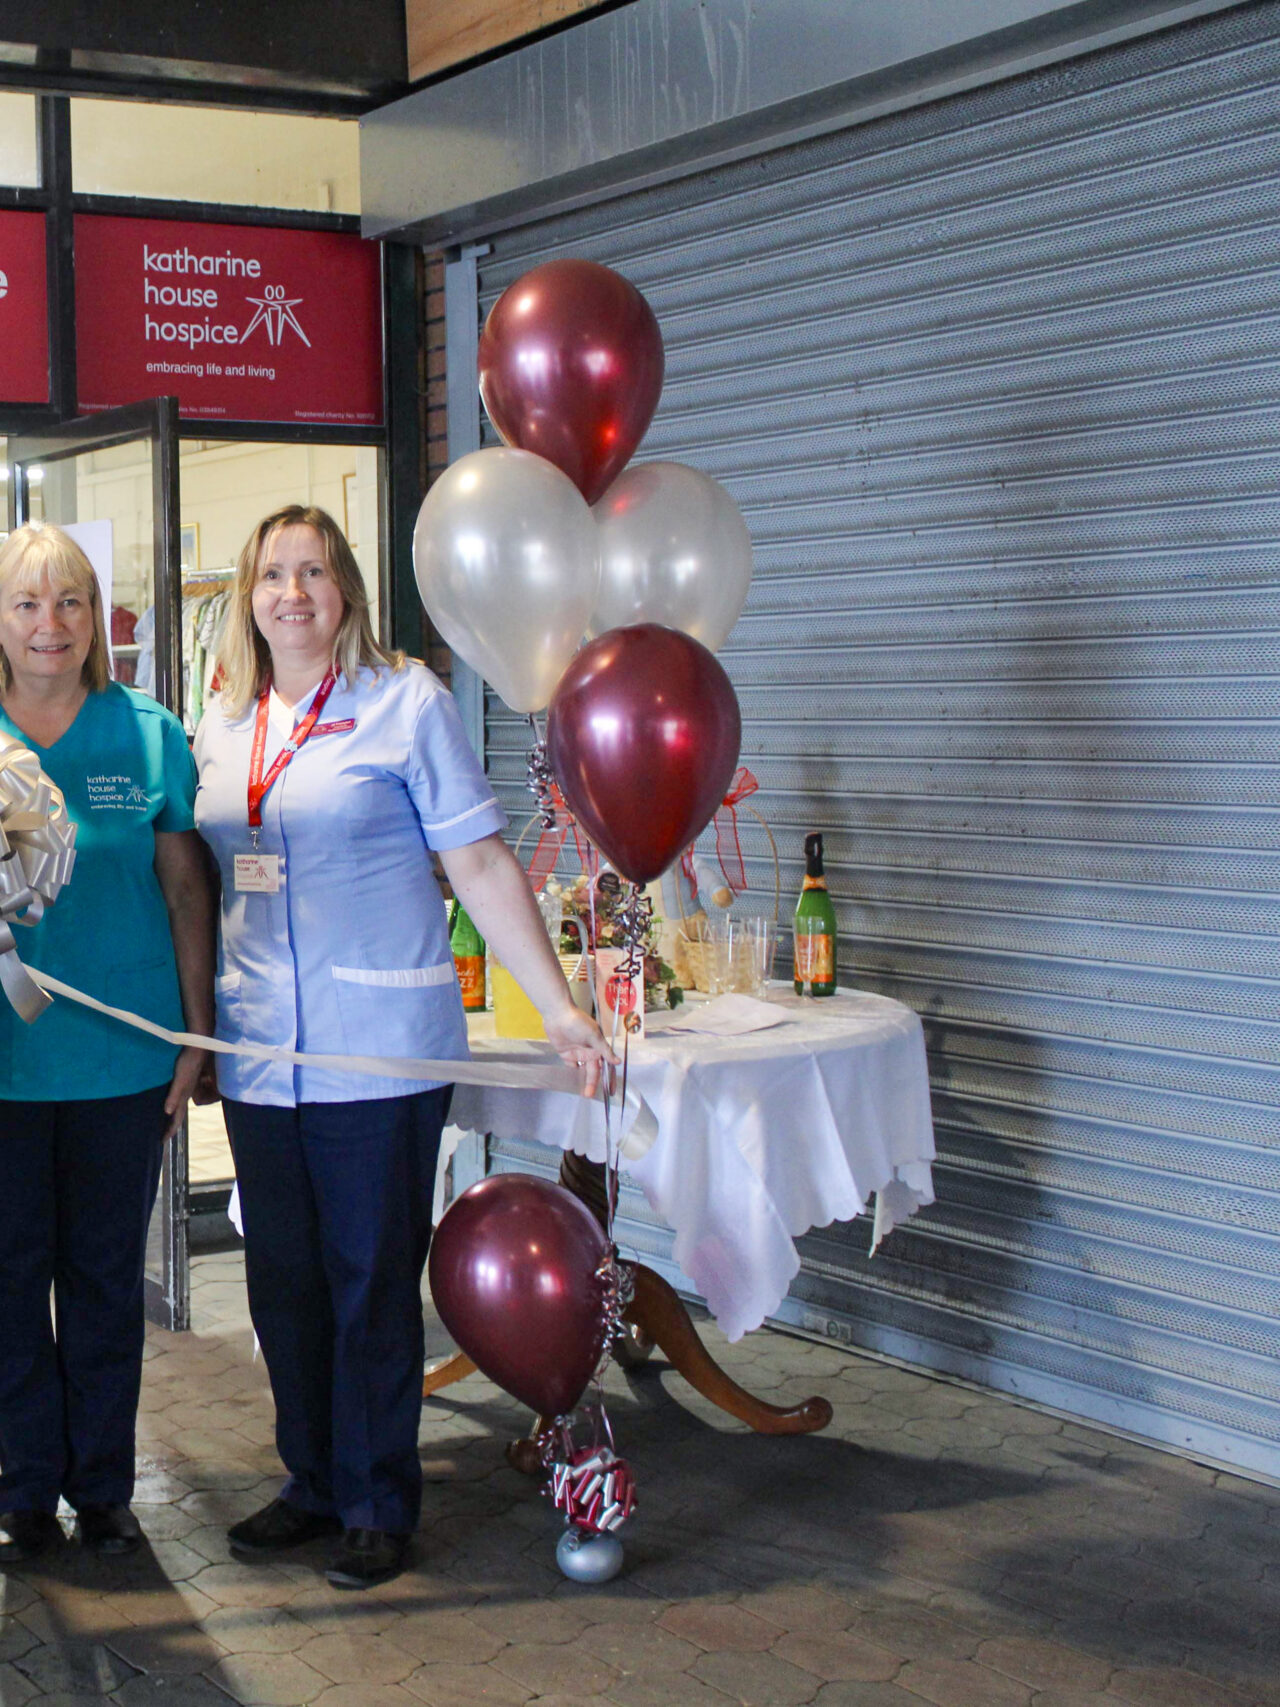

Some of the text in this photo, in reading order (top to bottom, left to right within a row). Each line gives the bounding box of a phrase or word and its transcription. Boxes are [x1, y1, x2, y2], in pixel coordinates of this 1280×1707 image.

[143, 244, 261, 278] katharine
[144, 277, 218, 308] house
[145, 313, 239, 350] hospice
[145, 360, 276, 381] embracing life and living
[86, 774, 131, 784] katharine
[88, 784, 116, 793] house
